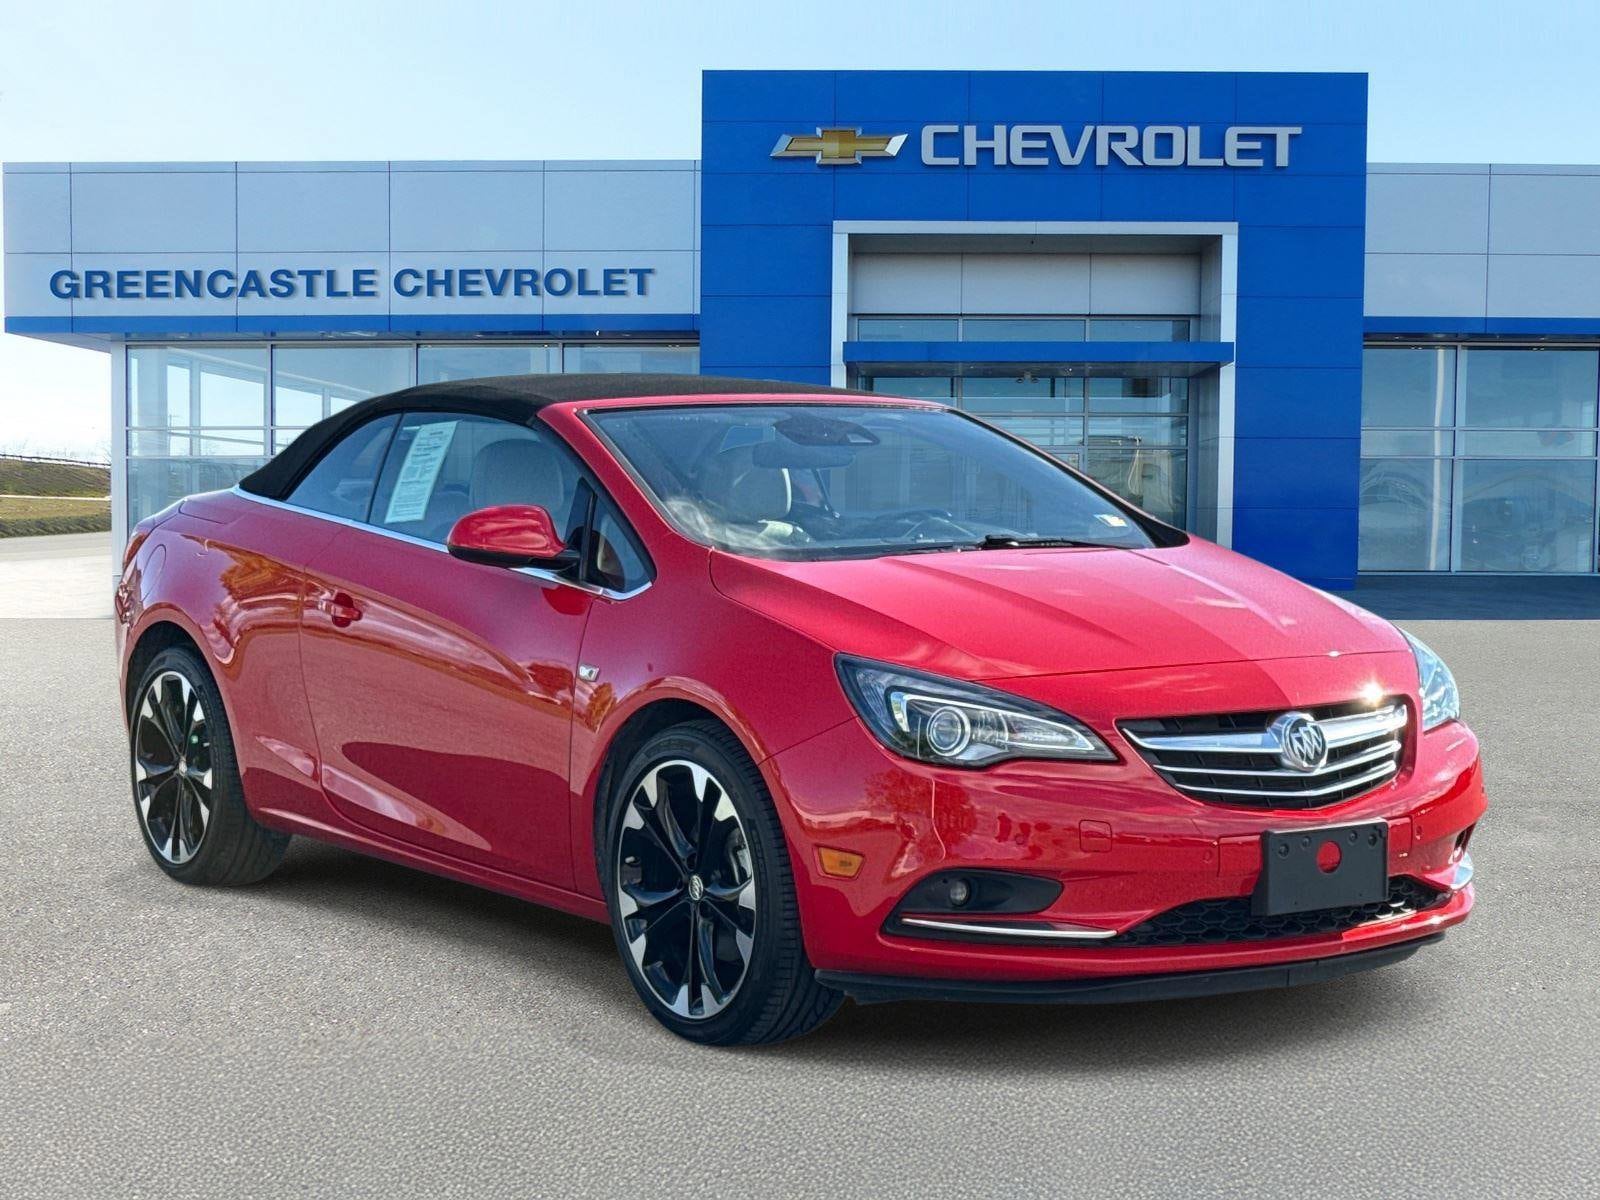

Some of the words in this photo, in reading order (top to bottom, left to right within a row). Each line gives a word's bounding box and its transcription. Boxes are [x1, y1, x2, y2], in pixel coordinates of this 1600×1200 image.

[921, 124, 1302, 167] CHEVROLET
[50, 268, 379, 299] GREENCASTLE
[394, 267, 655, 297] CHEVROLET
